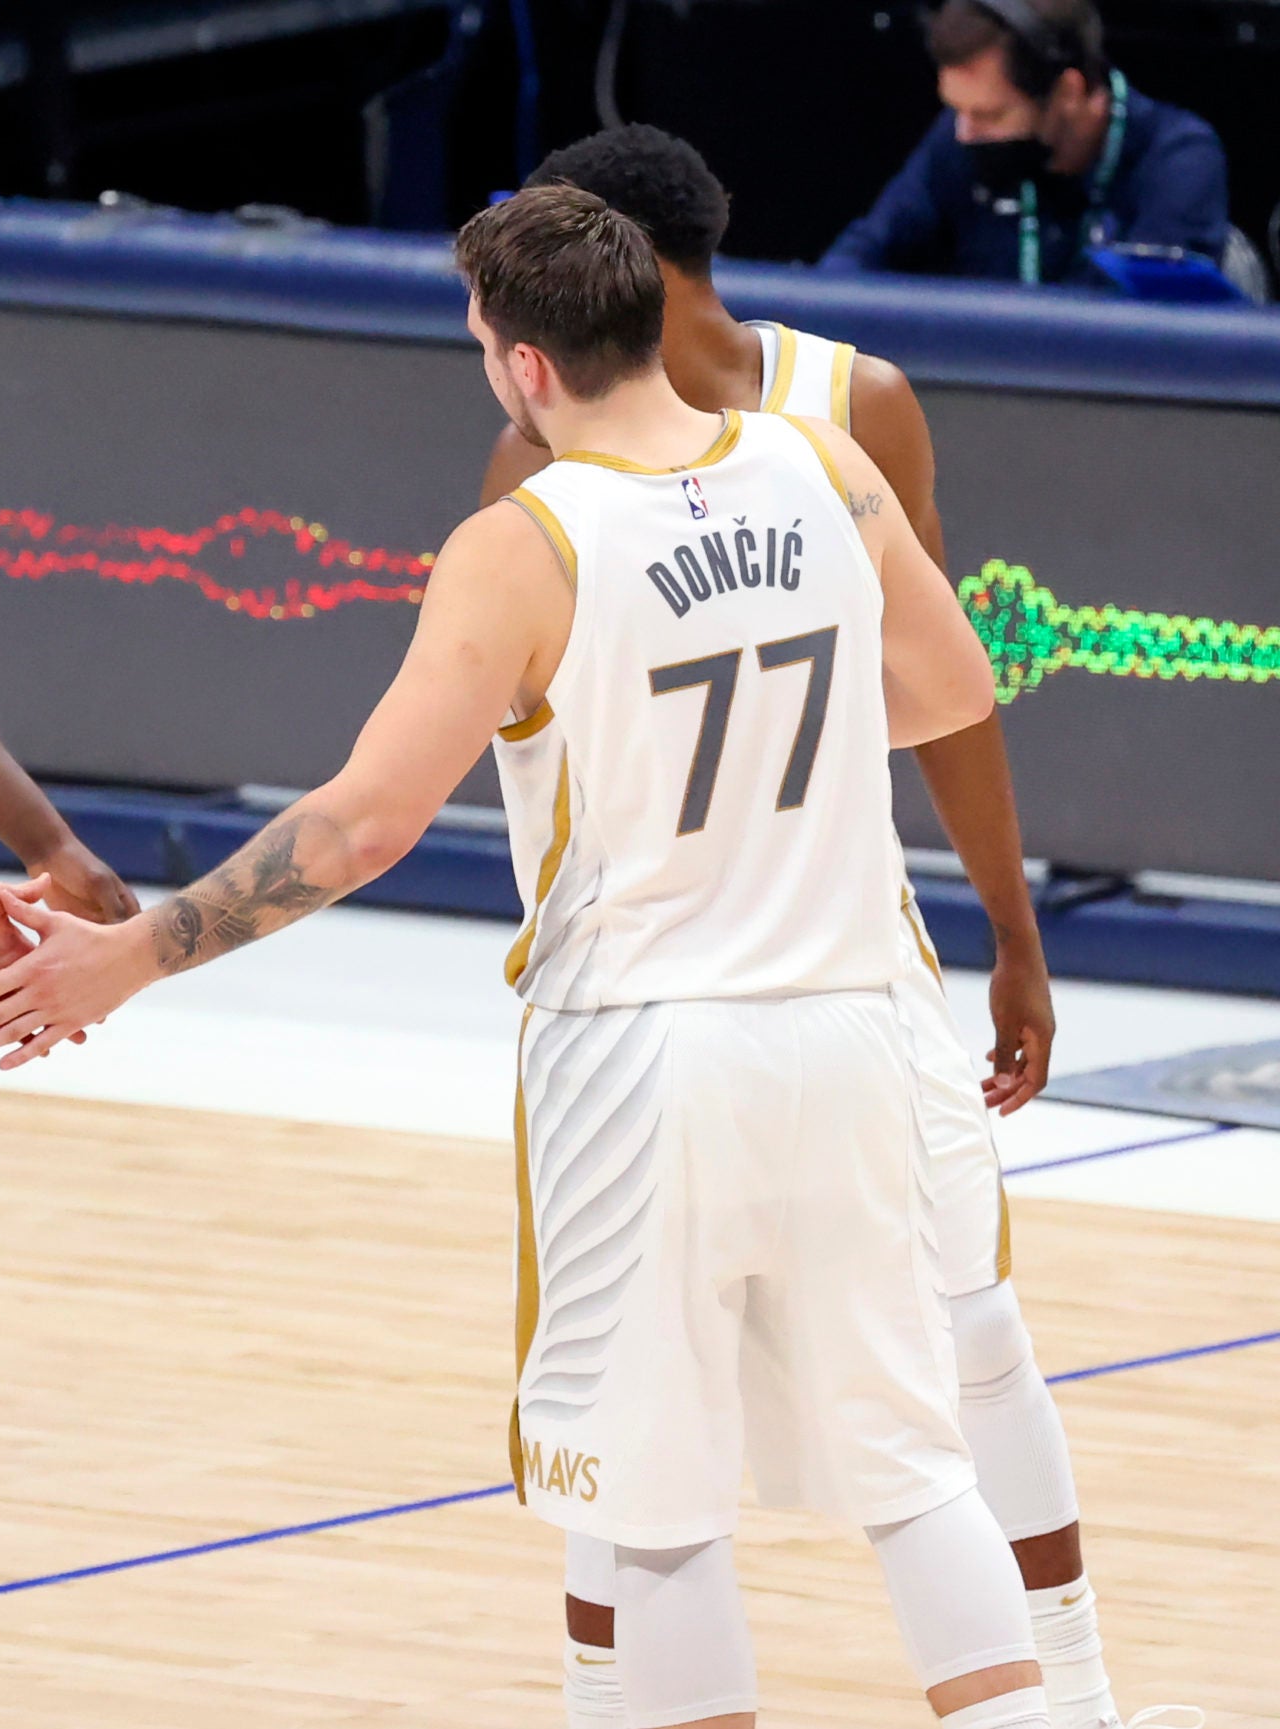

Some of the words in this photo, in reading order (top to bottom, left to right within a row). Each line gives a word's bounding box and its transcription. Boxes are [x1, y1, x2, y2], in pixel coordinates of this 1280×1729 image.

[646, 515, 803, 619] DONČIĆ
[648, 624, 839, 838] 77
[522, 1436, 600, 1502] MAVS
